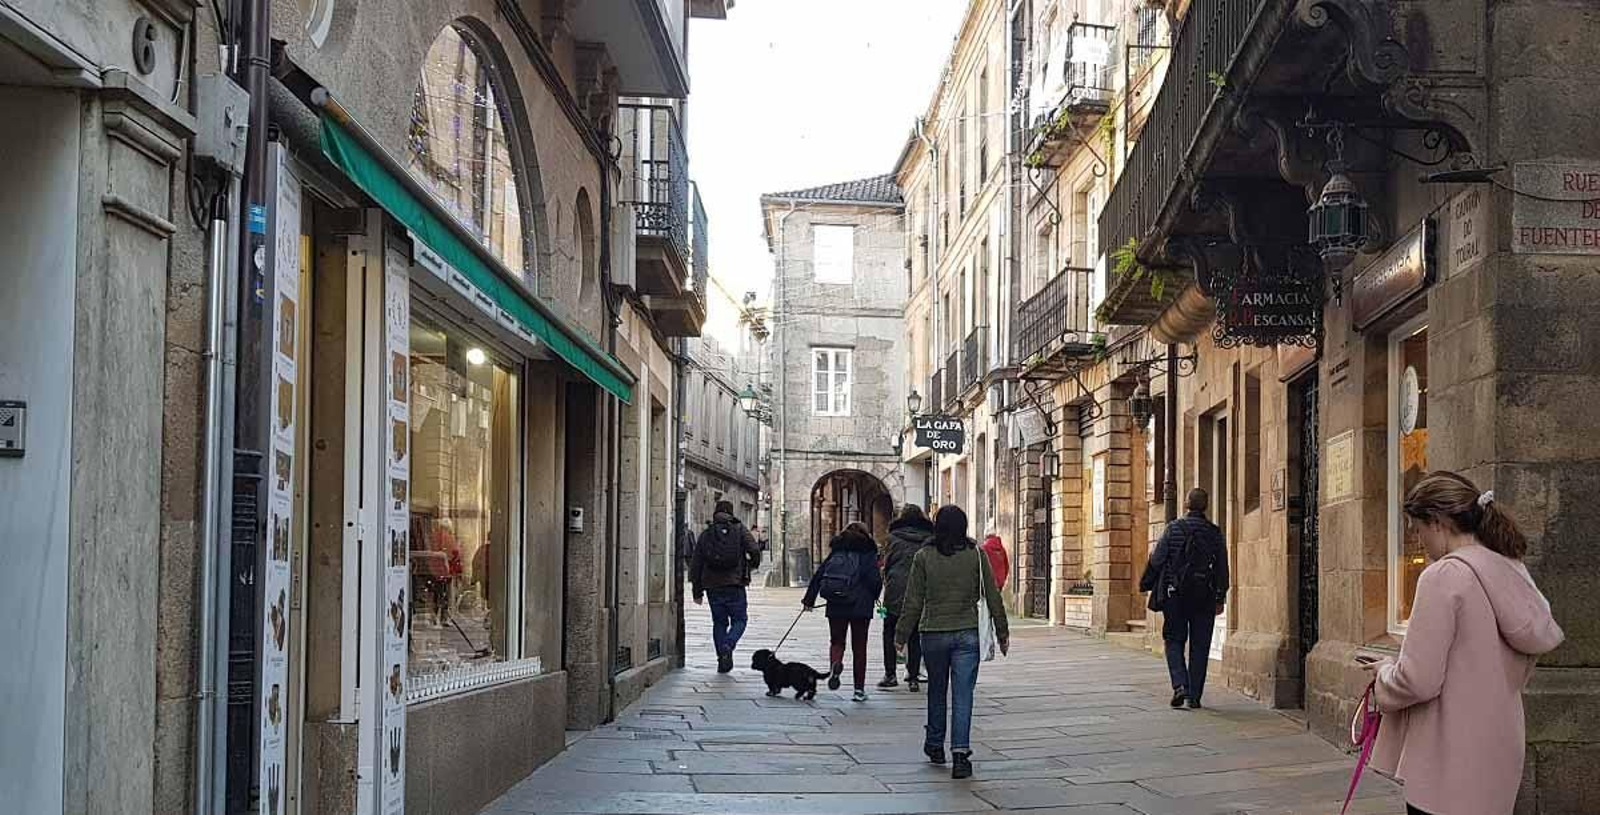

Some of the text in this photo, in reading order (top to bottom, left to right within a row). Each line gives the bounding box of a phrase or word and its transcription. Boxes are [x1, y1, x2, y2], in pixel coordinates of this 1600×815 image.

[132, 16, 157, 75] 6
[1563, 172, 1600, 192] RUE
[1231, 284, 1312, 306] FARMACIA
[916, 420, 932, 429] LA
[926, 430, 941, 439] DE
[932, 441, 957, 449] ORO
